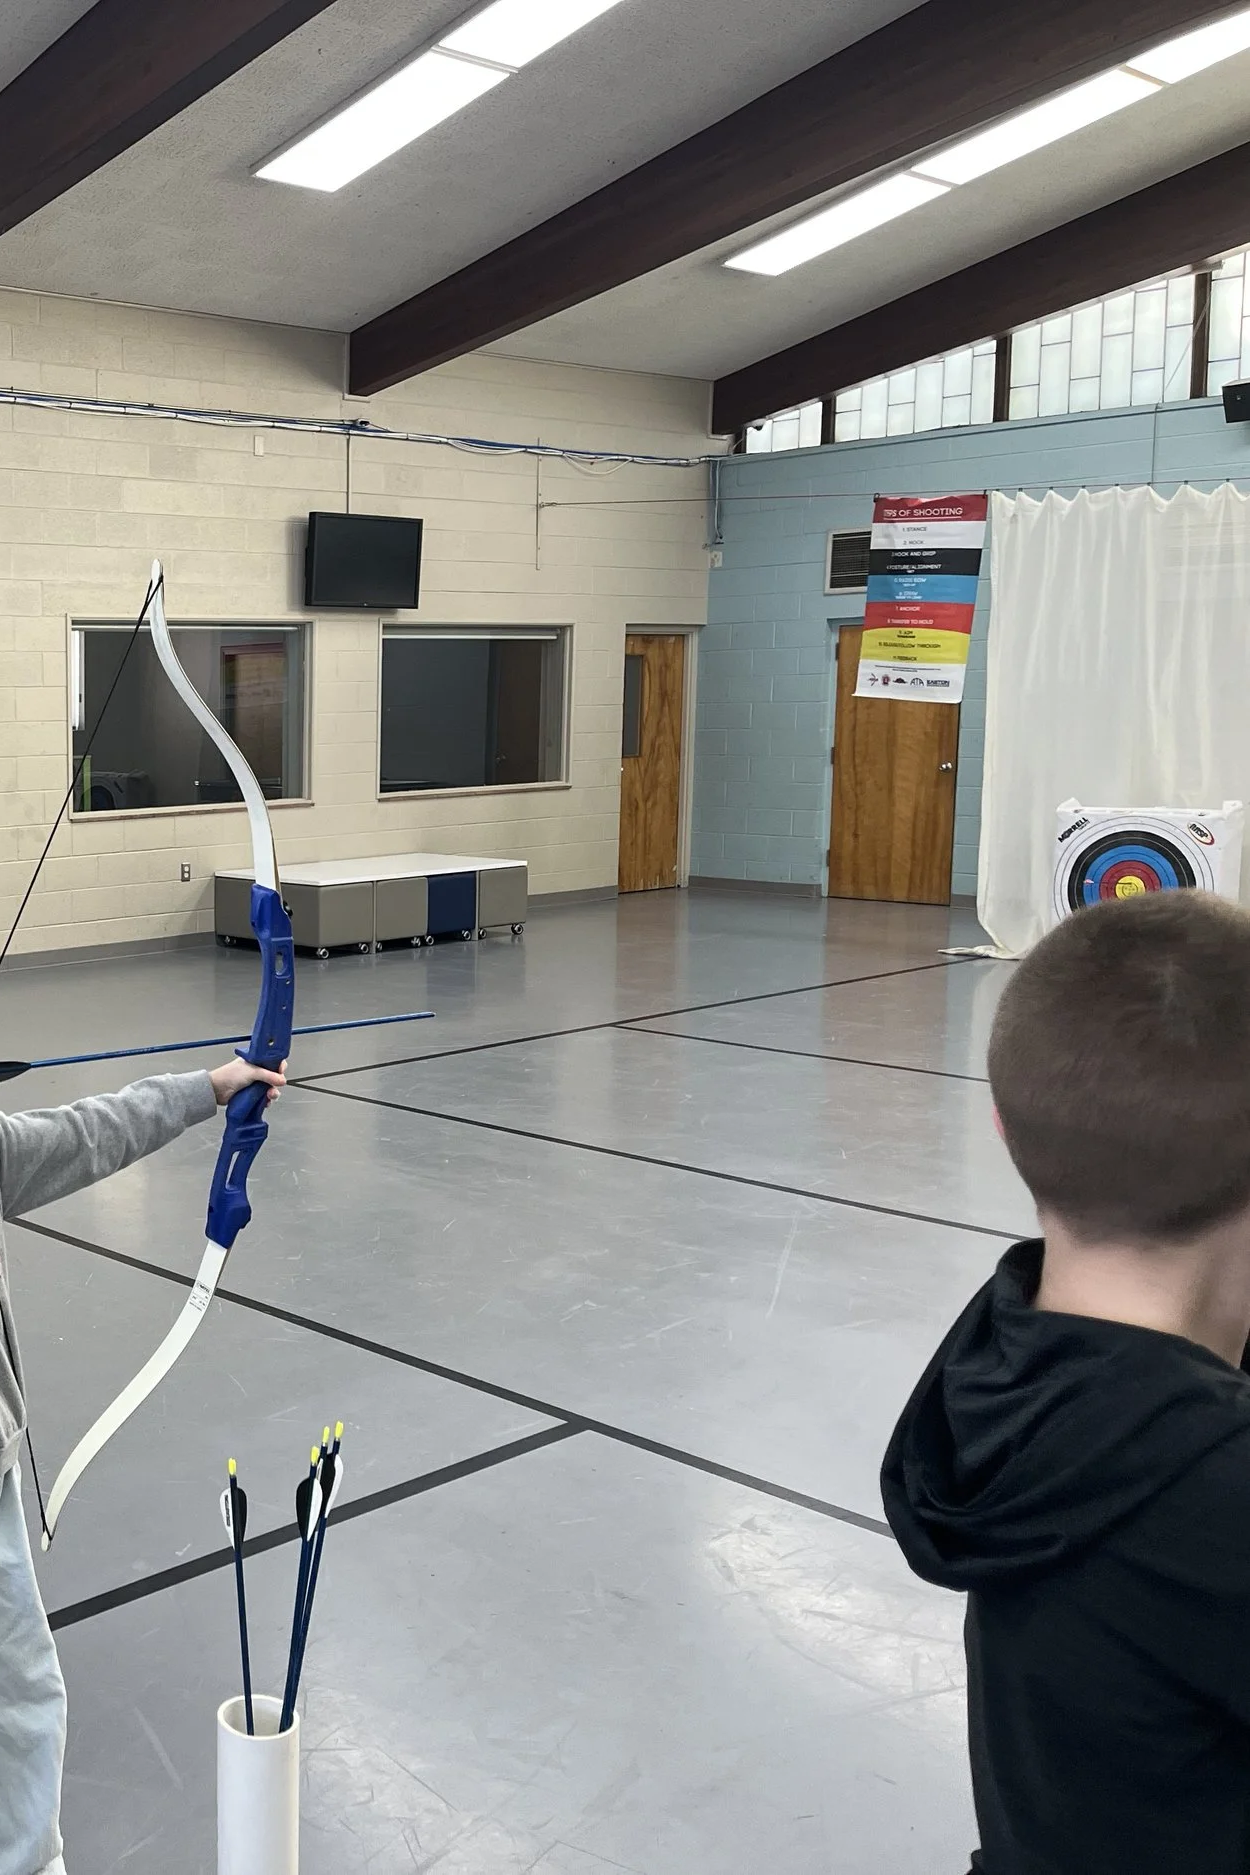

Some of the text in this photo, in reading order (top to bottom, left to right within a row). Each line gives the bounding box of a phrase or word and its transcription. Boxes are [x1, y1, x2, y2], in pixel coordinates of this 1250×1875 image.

[898, 509, 911, 517] OF
[913, 507, 963, 516] SHOOTING
[1058, 817, 1089, 843] MORRELL
